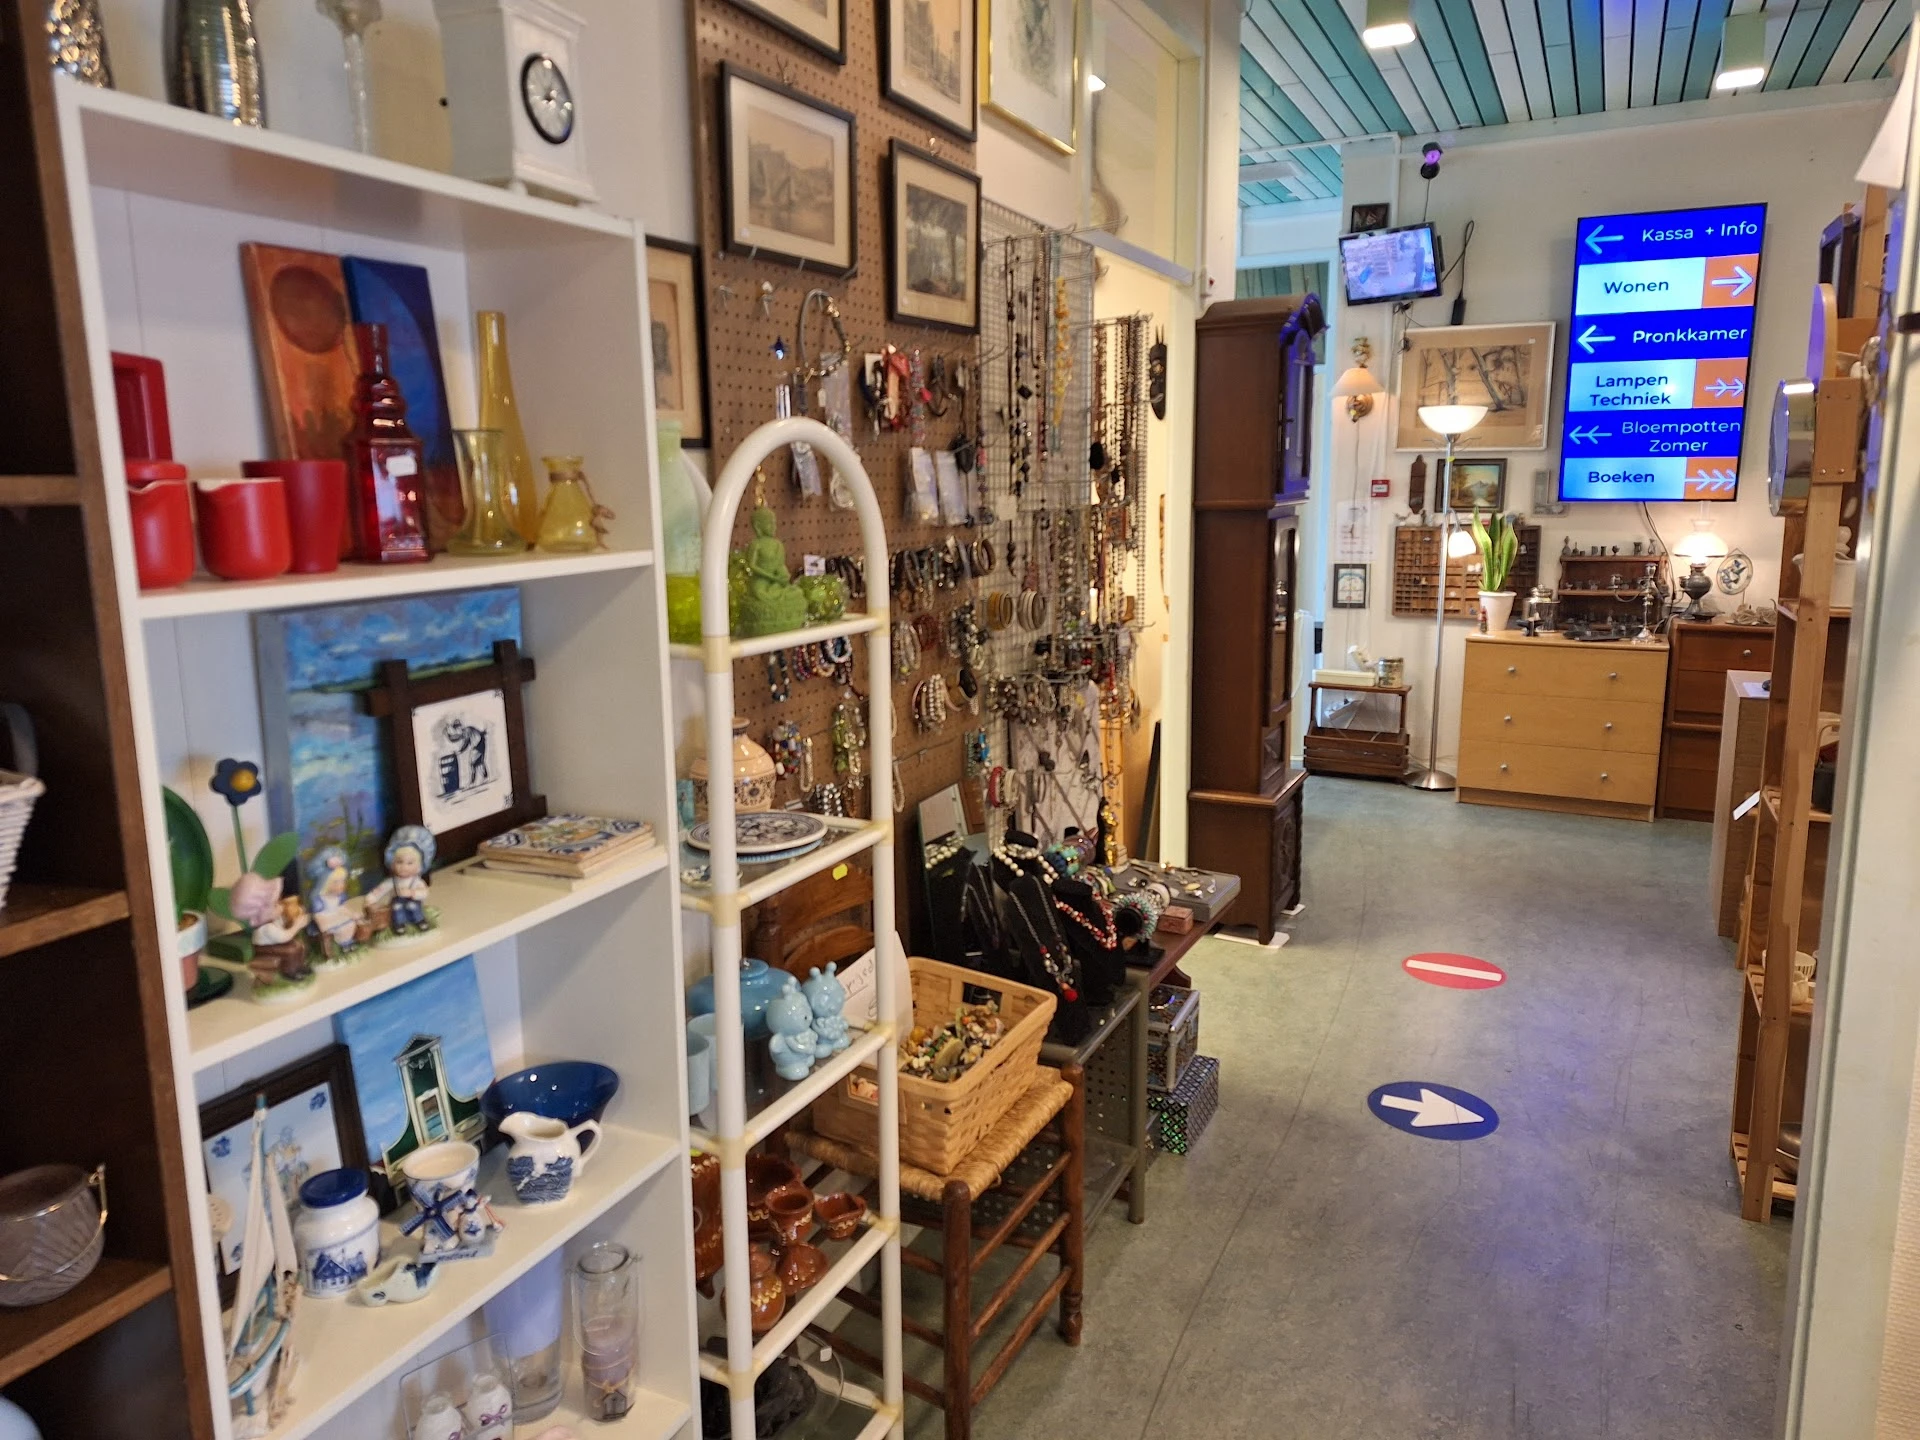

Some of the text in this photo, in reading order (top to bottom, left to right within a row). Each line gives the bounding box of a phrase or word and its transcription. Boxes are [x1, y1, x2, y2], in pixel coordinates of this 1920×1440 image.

[1641, 221, 1758, 242] Kassa + Info
[1604, 280, 1669, 294] Wonen
[1632, 327, 1748, 343] Pronkkamer
[1596, 375, 1668, 390] Lampen
[1590, 392, 1671, 406] Techniek
[1621, 420, 1741, 436] Bloempotten
[1648, 440, 1709, 453] Zomer
[1588, 470, 1655, 483] Boeken
